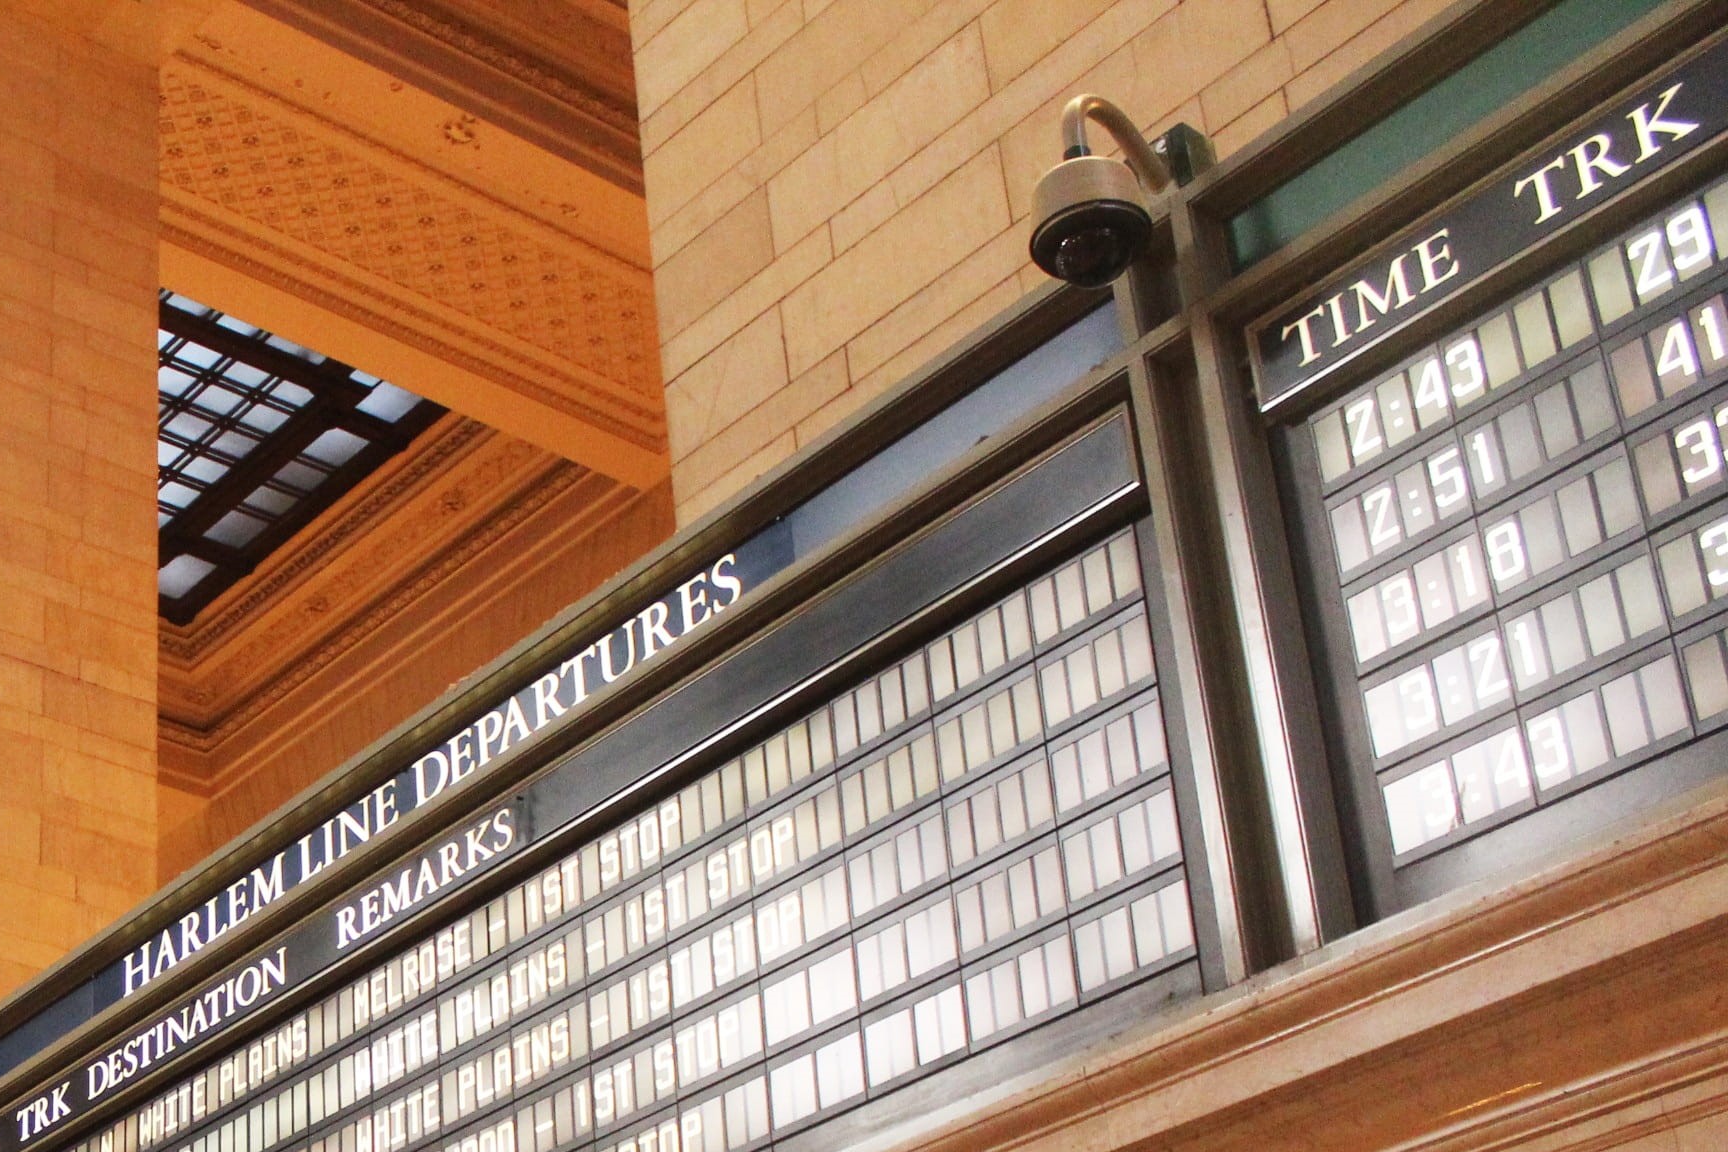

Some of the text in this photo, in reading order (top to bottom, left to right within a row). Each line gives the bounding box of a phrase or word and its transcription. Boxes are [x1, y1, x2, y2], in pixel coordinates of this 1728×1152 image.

[1280, 82, 1700, 367] TIME TRK
[1346, 205, 1714, 458] 2:43 29
[1363, 306, 1726, 547] 2:51 41
[1382, 406, 1728, 635] 3:18 3
[122, 552, 742, 1000] HARLEM LINE DEPARTURES
[1399, 621, 1538, 730] 3:21
[1419, 715, 1569, 829] 3:43
[16, 1086, 72, 1142] TRK
[86, 948, 289, 1102] DESTINATION
[335, 808, 514, 950] REMARKS
[139, 1085, 206, 1148] WHITE
[220, 1017, 309, 1098] PLAINS
[354, 920, 471, 1026] MELROSE
[528, 858, 580, 918] 1ST
[600, 802, 682, 882] STOP
[354, 1013, 437, 1095] WHITE
[457, 942, 566, 1039] PLAINS
[628, 872, 685, 940] 1ST
[708, 814, 794, 902] STOP
[459, 1015, 569, 1110] PLAINS
[633, 948, 692, 1020] 1ST
[713, 893, 802, 985] STOP
[578, 1058, 632, 1129] 1ST
[654, 1012, 740, 1098] STOP
